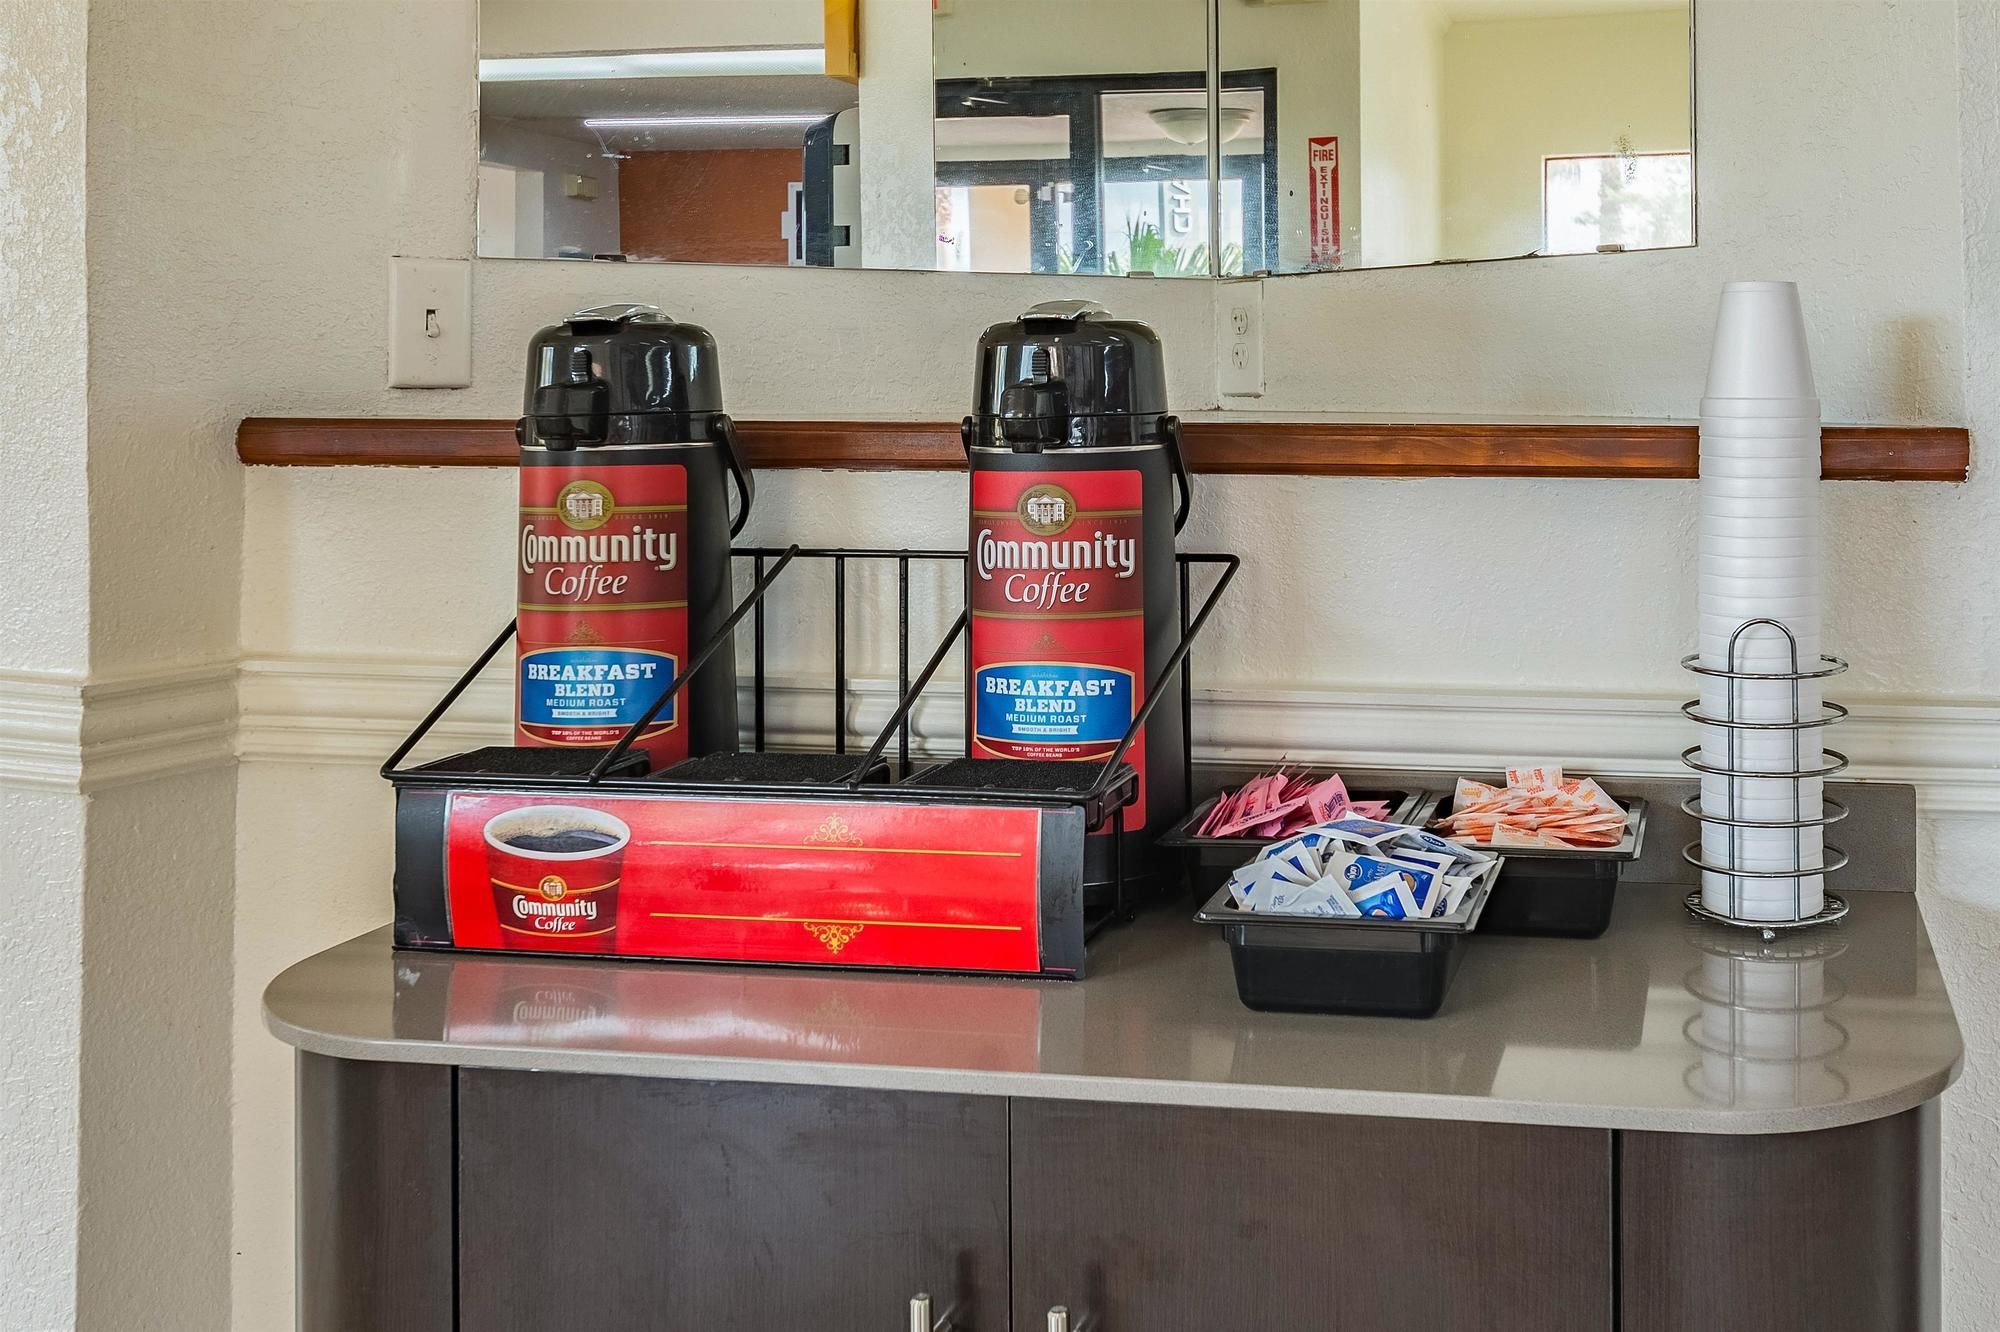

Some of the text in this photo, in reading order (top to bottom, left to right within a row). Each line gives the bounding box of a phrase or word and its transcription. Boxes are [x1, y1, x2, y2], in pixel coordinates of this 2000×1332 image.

[1313, 149, 1334, 161] FIRE
[522, 524, 677, 574] Community
[977, 528, 1136, 581] Community
[544, 564, 629, 602] Coffee
[1004, 571, 1091, 610] Coffee
[528, 663, 657, 681] BREAKFAST
[554, 683, 616, 697] BLEND
[985, 676, 1116, 697] BREAKFAST
[546, 698, 627, 707] MEDIUM ROAST
[1014, 698, 1077, 713] BLEND
[1005, 713, 1087, 723] MEDIUM ROAST
[512, 894, 598, 920] Community
[534, 916, 577, 933] Coffee
